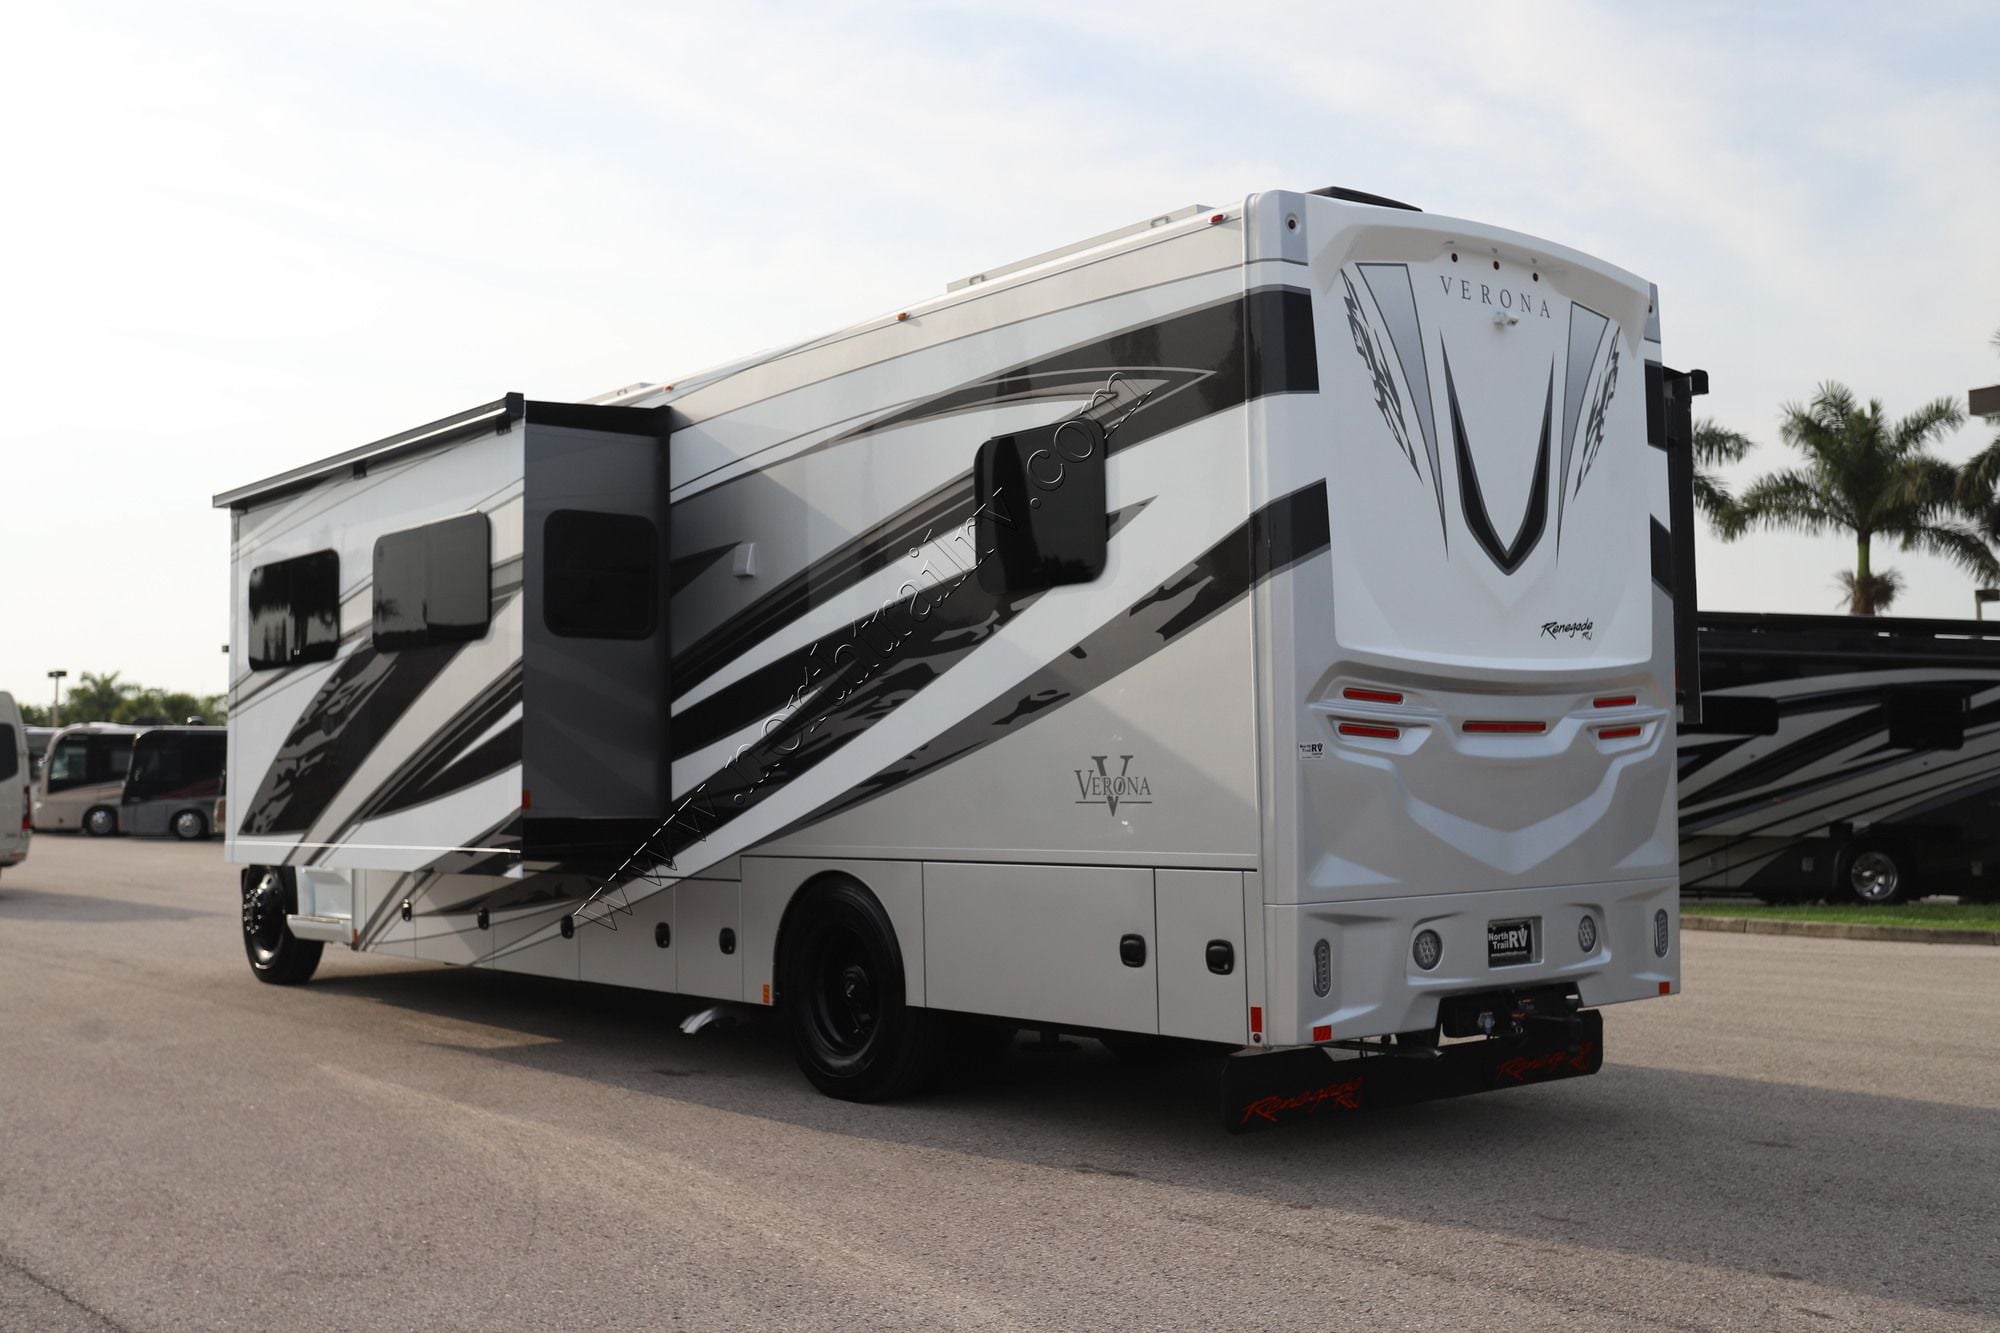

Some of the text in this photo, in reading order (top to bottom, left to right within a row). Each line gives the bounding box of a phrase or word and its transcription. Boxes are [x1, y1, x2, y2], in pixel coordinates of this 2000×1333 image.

[1440, 275, 1551, 319] VERONA
[1541, 617, 1593, 640] Renegade
[1311, 743, 1323, 752] RV
[1074, 769, 1152, 800] VERONA
[1488, 928, 1528, 948] North RV
[1492, 940, 1509, 950] Trail
